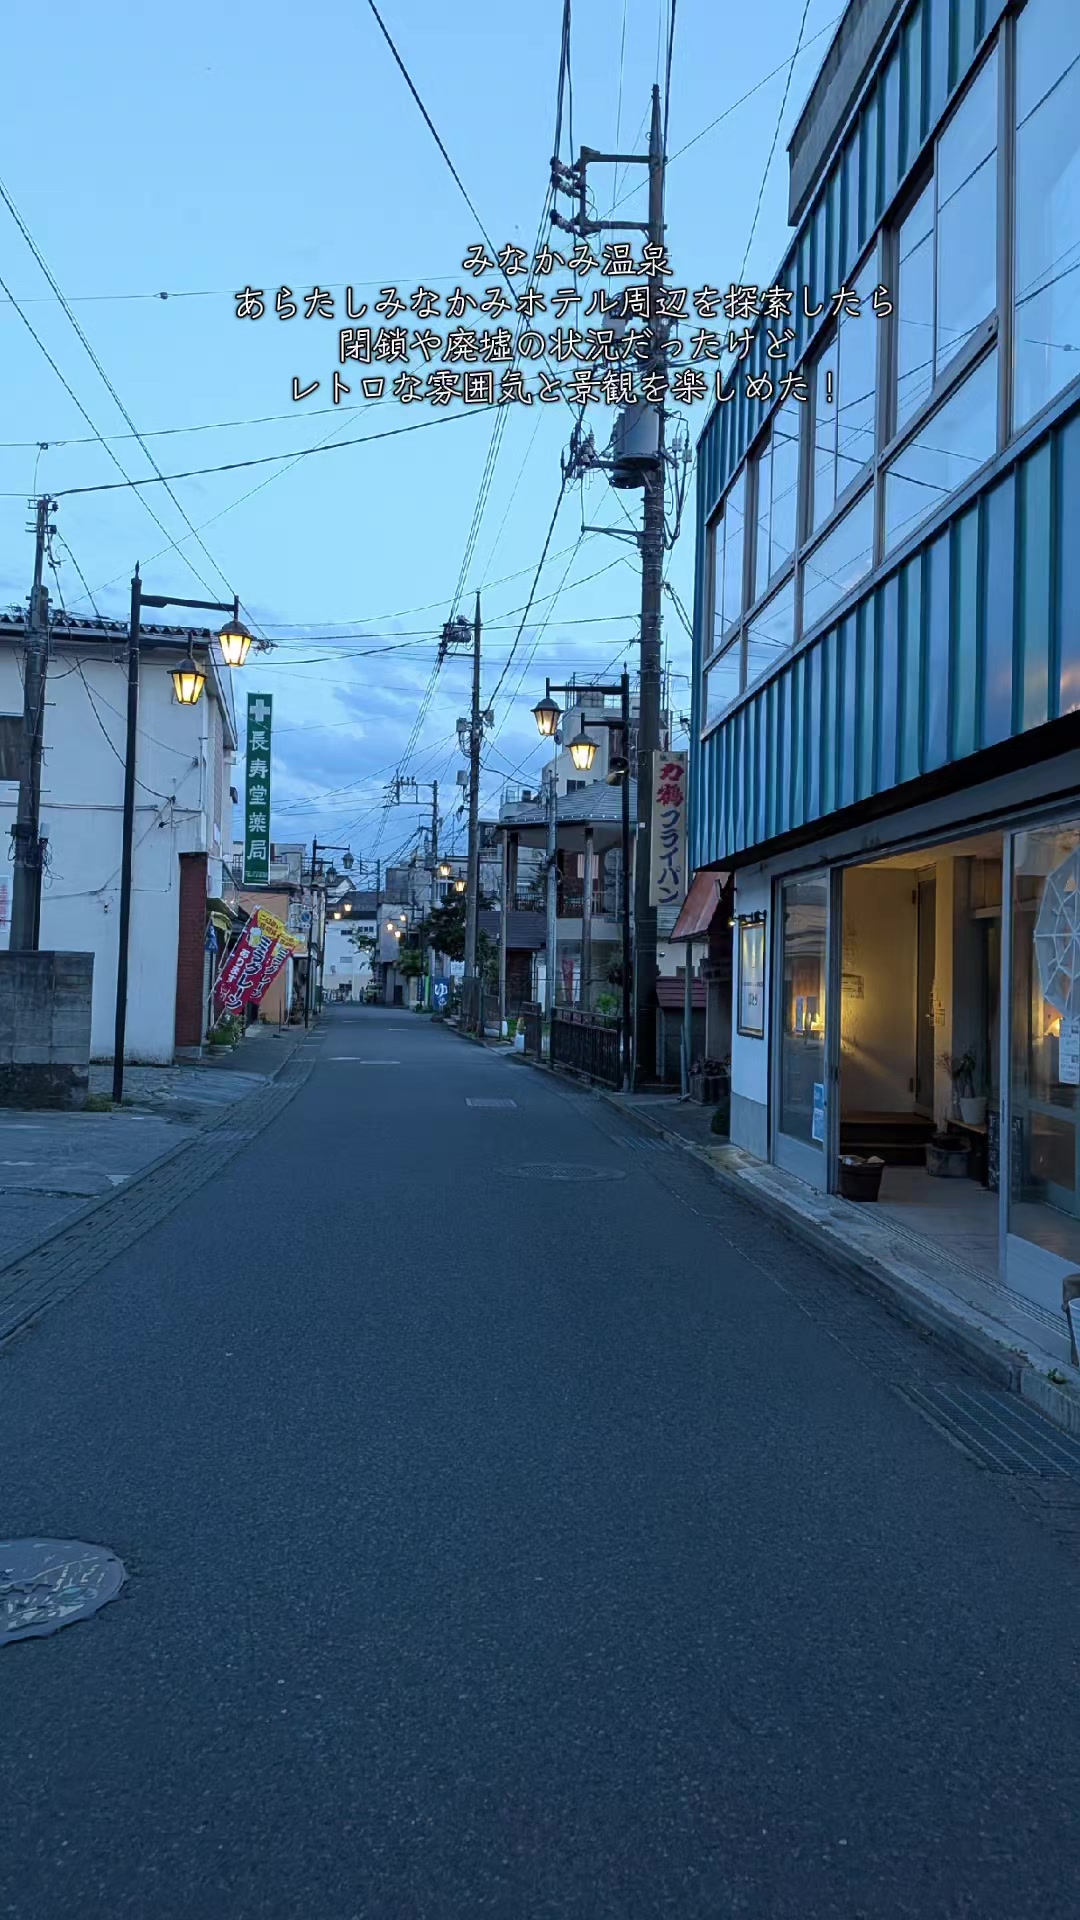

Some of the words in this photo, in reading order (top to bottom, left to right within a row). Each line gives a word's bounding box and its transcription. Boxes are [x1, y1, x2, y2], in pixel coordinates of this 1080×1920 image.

[247, 730, 269, 860] 長寿堂薬局
